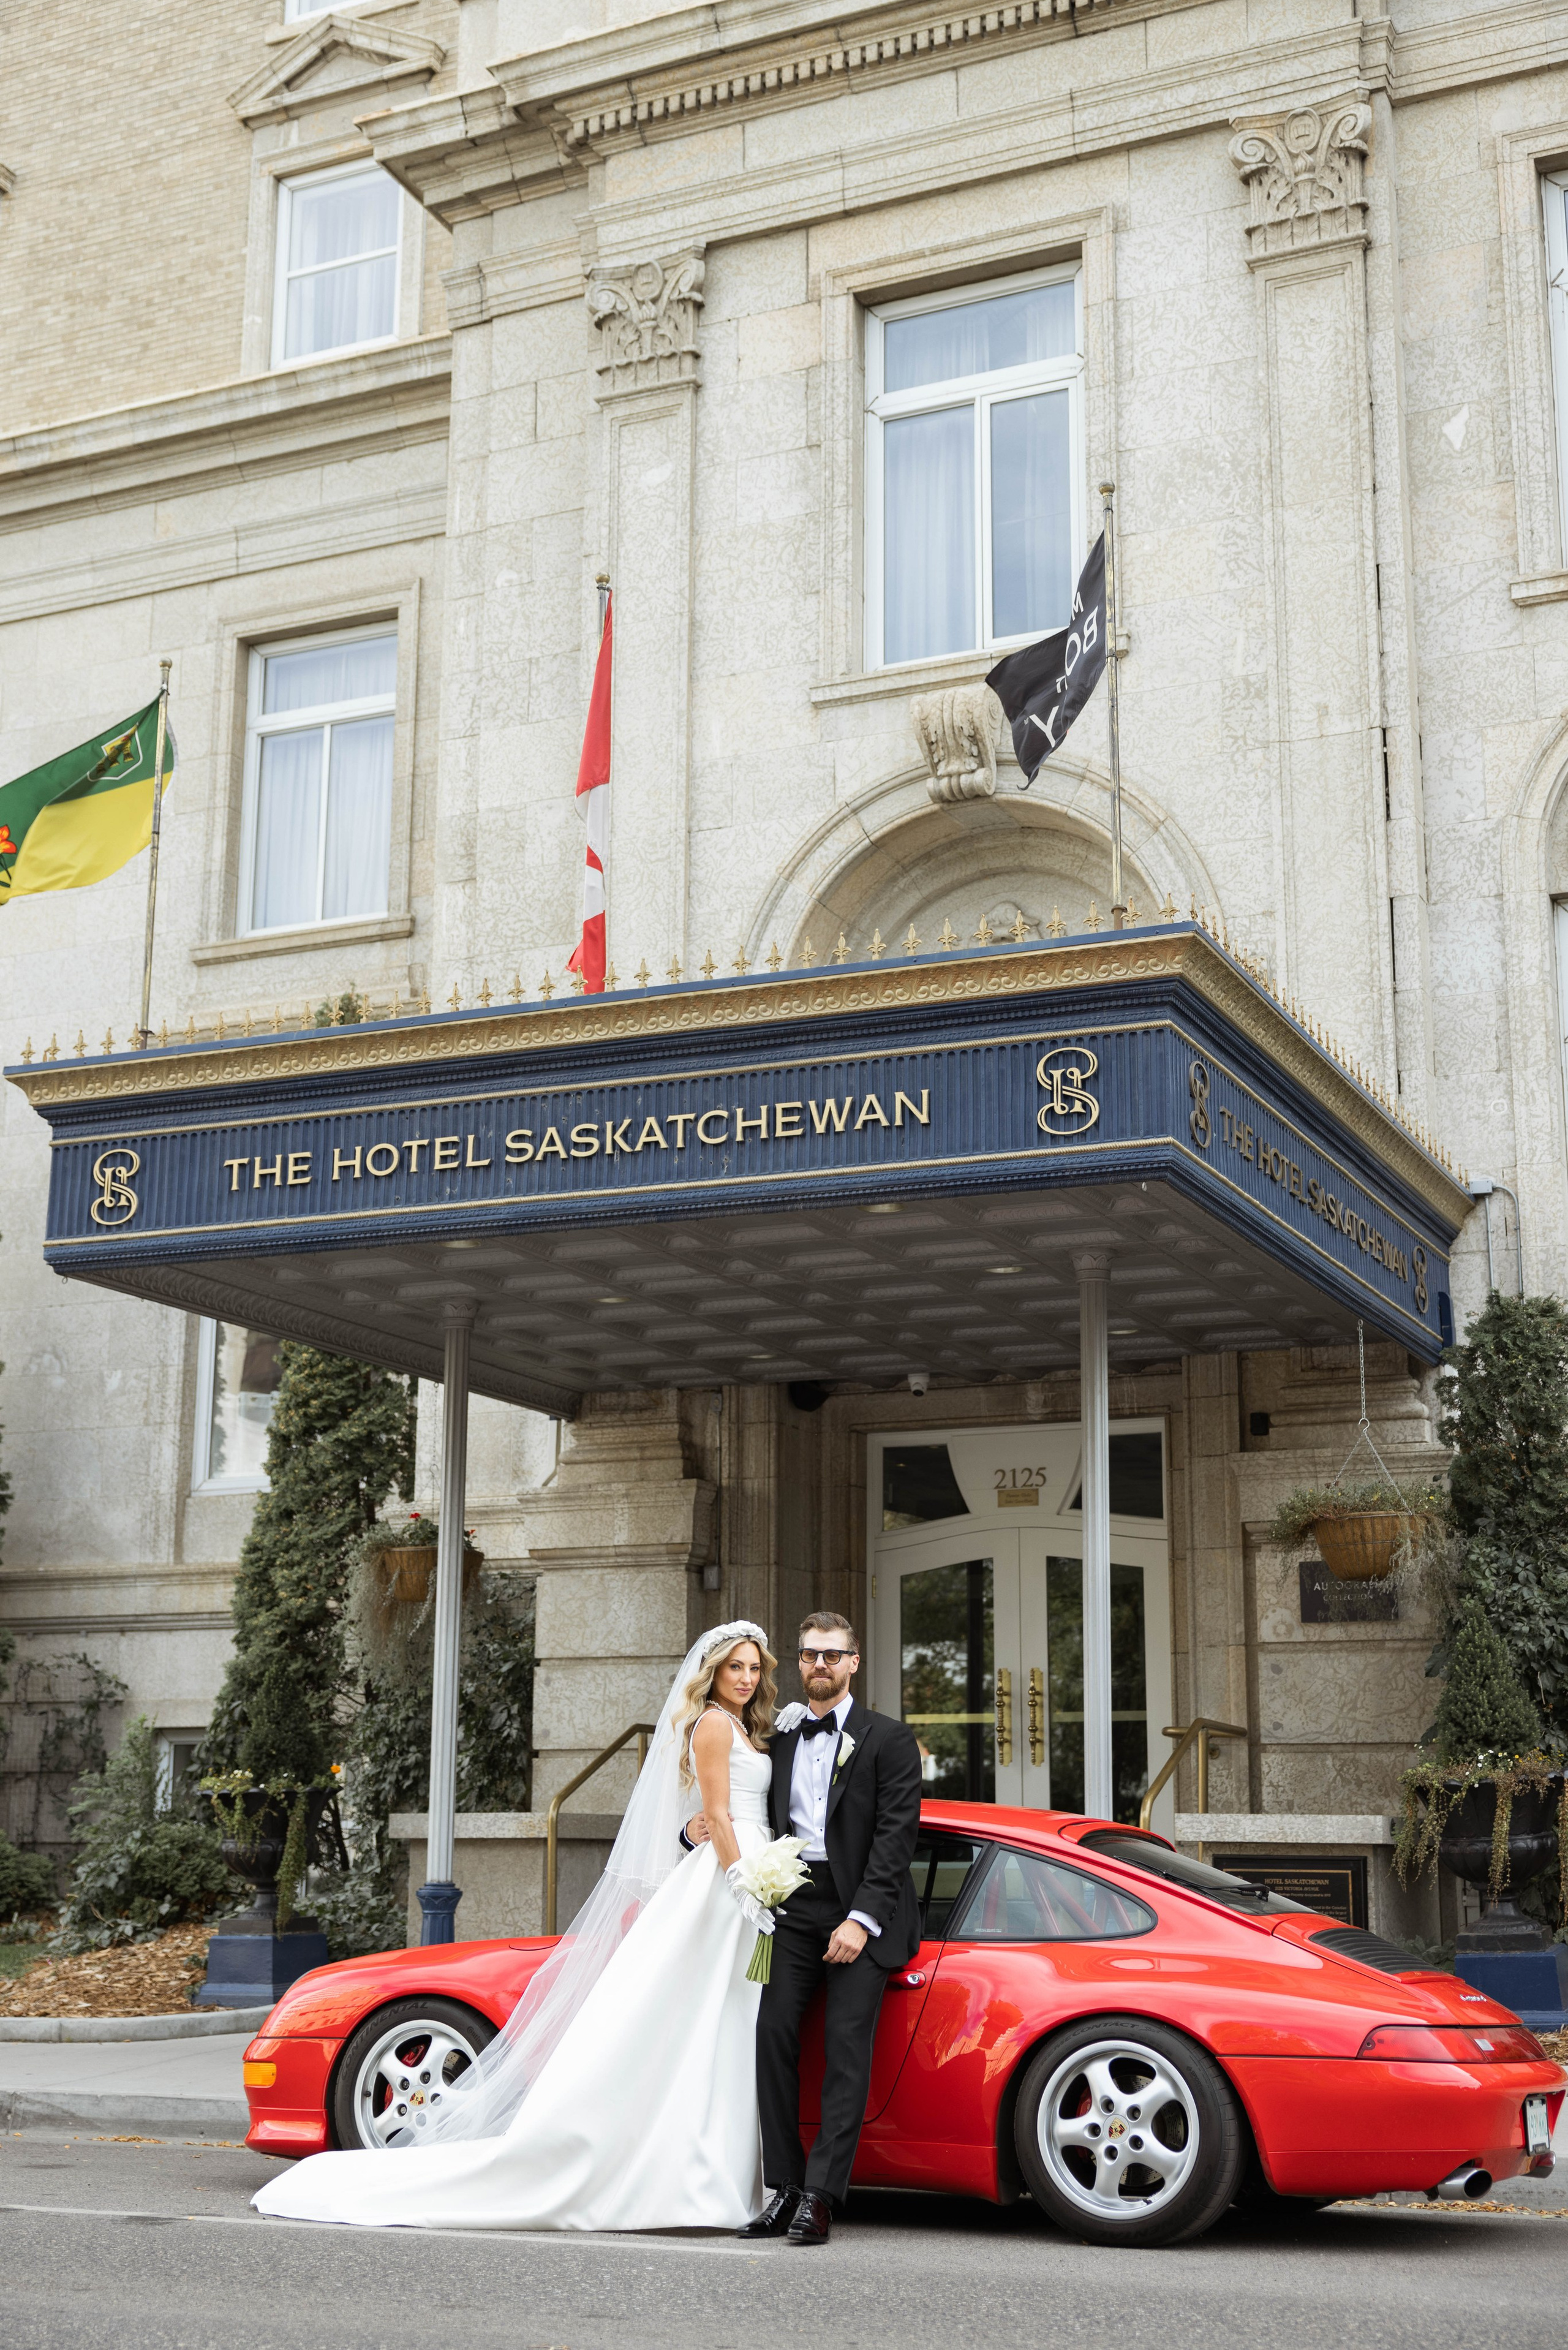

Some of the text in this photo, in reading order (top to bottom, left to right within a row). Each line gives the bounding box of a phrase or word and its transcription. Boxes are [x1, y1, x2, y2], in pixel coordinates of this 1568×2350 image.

[224, 1089, 930, 1192] THE HOTEL SASKATCHEWAN
[1219, 1106, 1408, 1283] THE HOTEL SASKATCHEWAN
[993, 1467, 1047, 1490] 2125
[342, 2001, 428, 2080] CONTINENTAL
